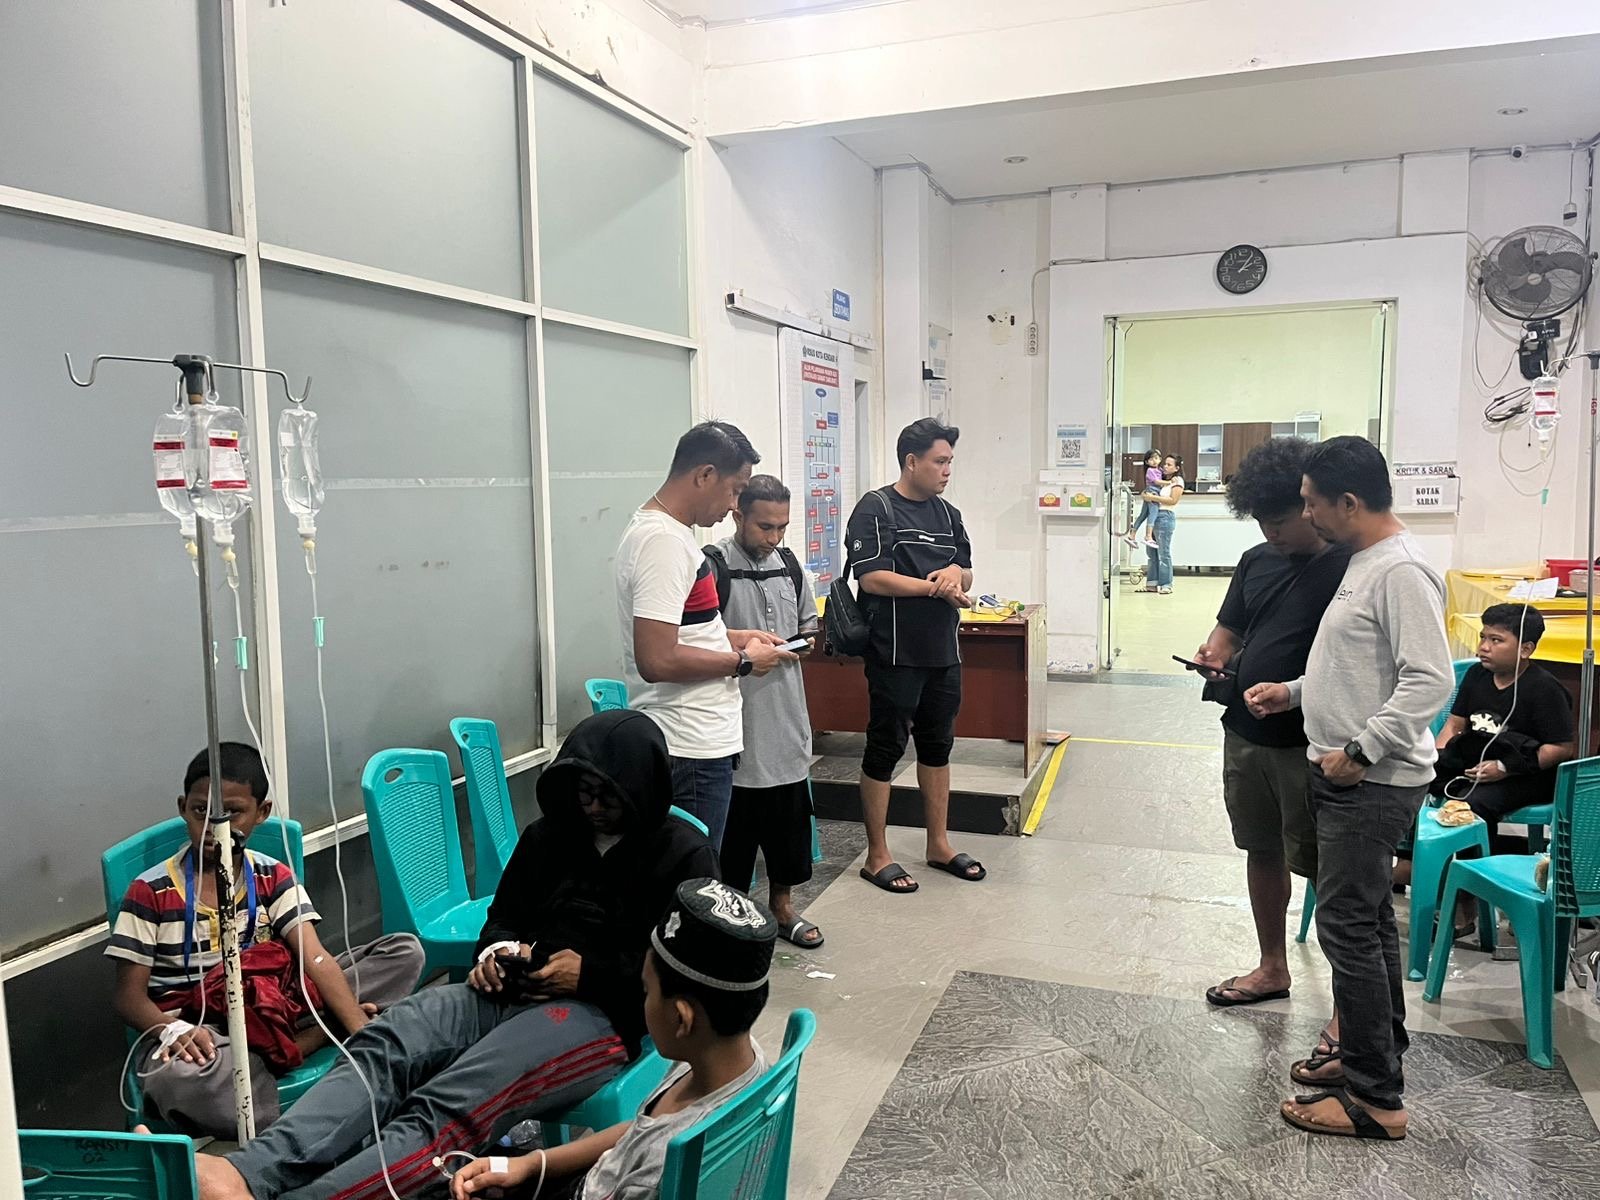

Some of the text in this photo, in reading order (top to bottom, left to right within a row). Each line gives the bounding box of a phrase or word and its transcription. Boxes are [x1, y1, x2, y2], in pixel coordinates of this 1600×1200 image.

[1256, 264, 1264, 273] 3
[1252, 273, 1260, 281] 4
[1245, 280, 1255, 288] 5
[1396, 466, 1454, 475] KRITIK & SARAN
[1416, 487, 1440, 495] KOTAK
[1416, 498, 1439, 506] SARAN
